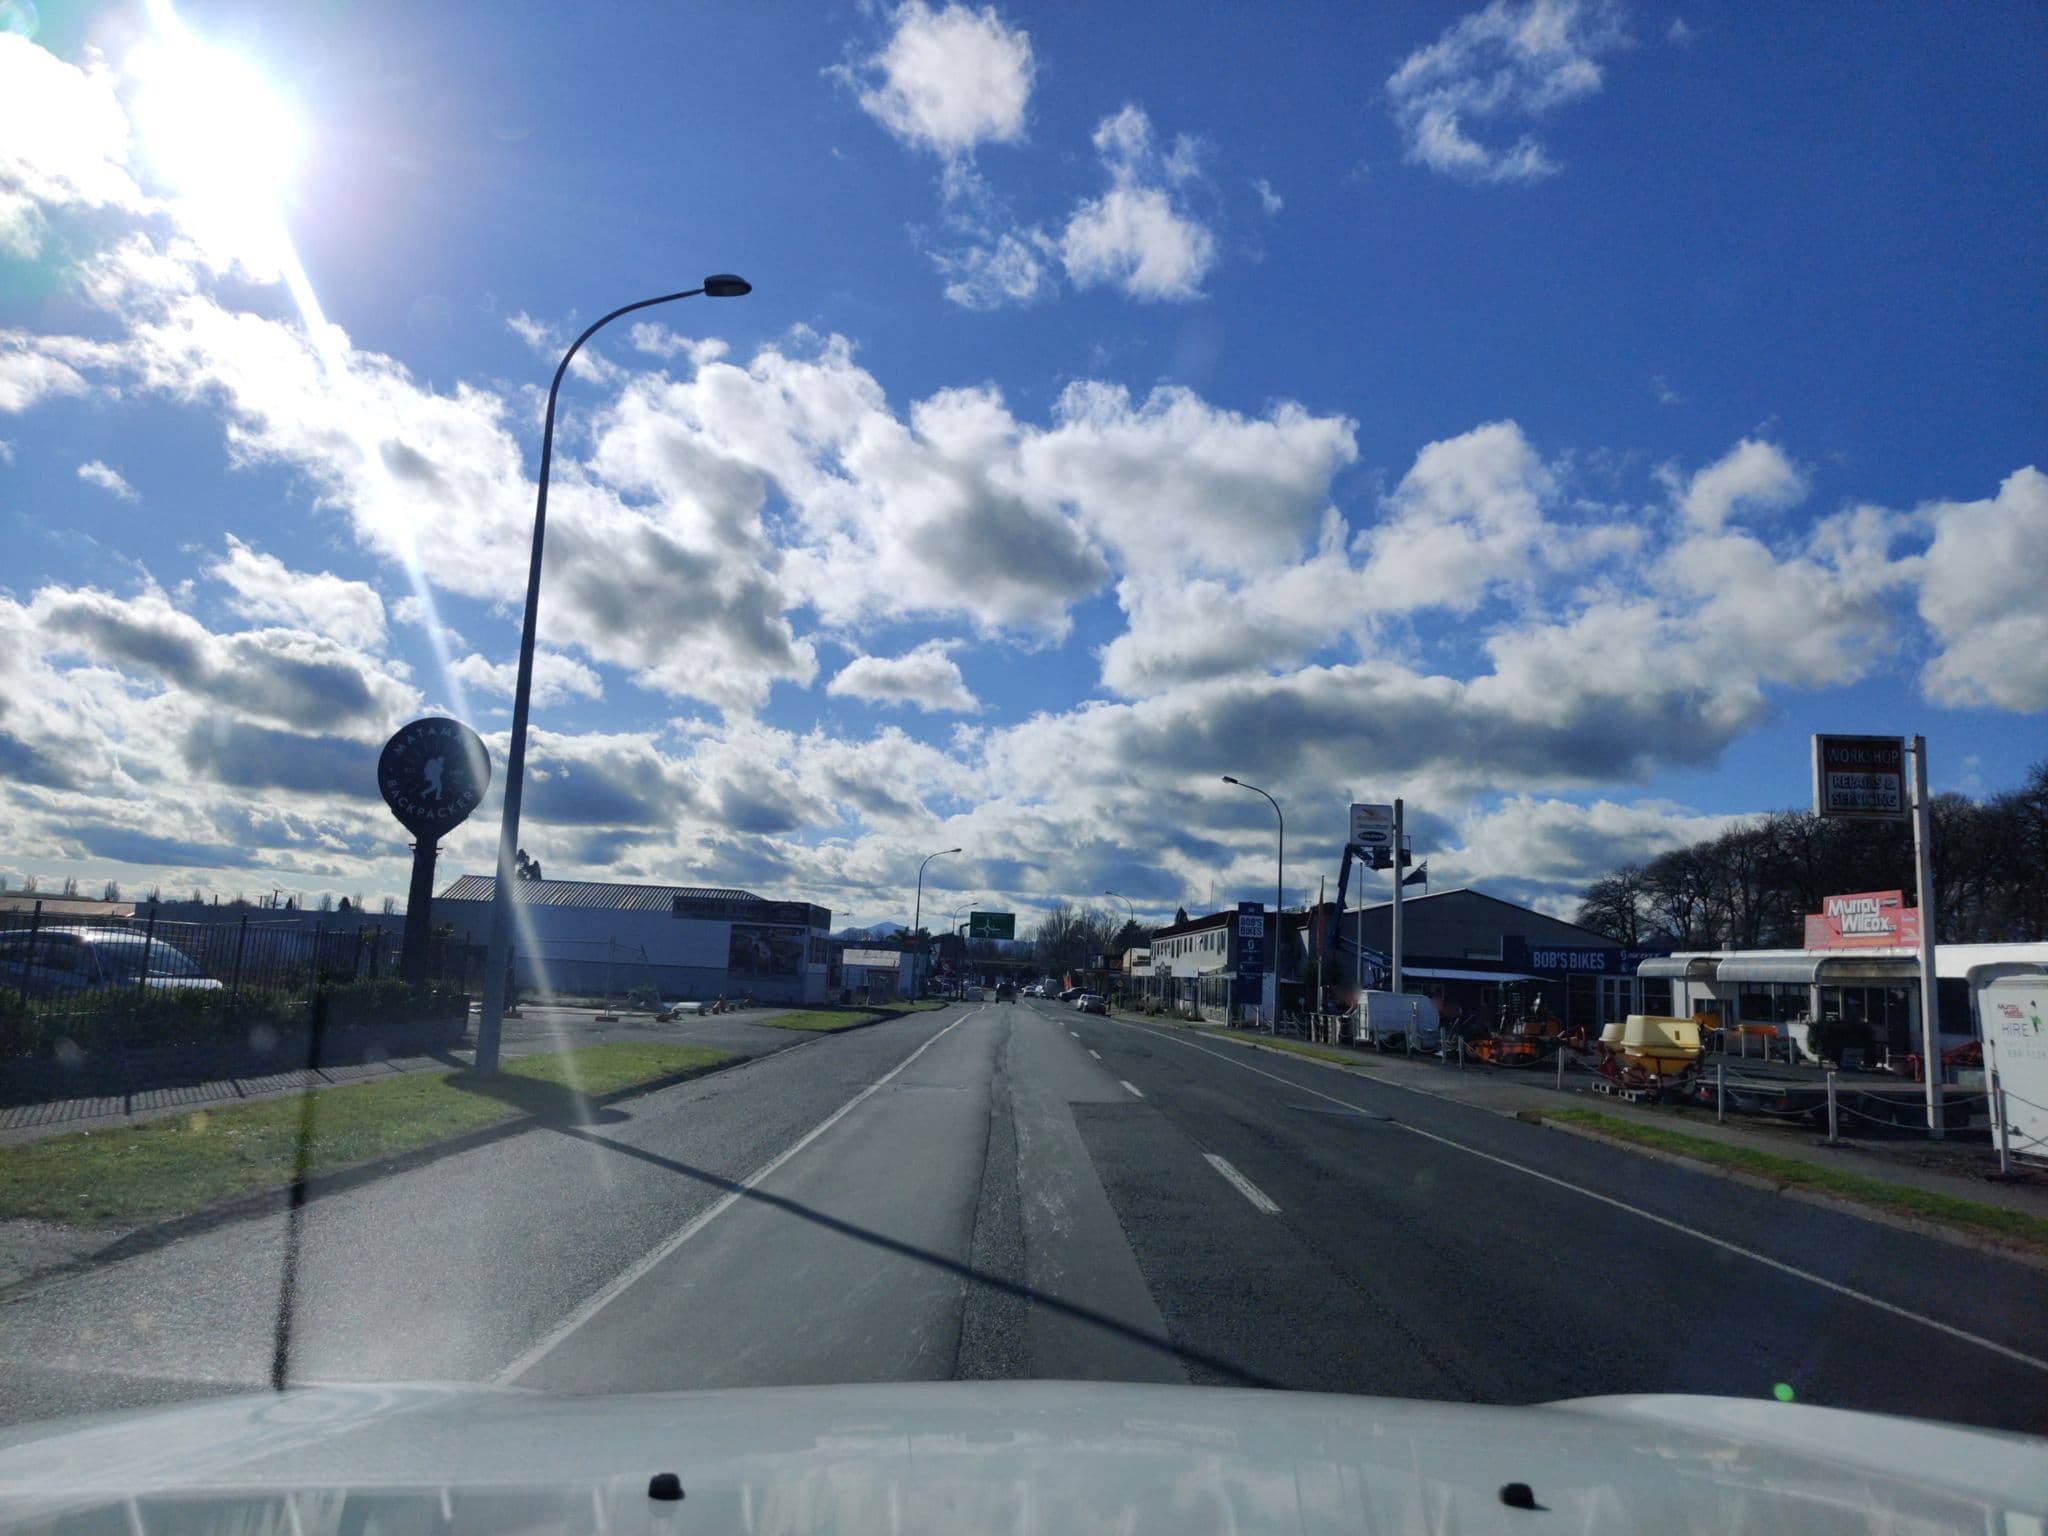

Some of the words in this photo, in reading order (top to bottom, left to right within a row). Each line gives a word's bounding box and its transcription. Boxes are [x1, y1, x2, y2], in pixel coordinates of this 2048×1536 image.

[1832, 775, 1881, 790] REPAIRS
[387, 779, 477, 820] BACKPACKER
[1833, 792, 1897, 806] SERVICING
[1828, 898, 1880, 917] Murray
[1842, 914, 1890, 932] Wilcox
[1533, 952, 1567, 968] BOB'S
[1570, 953, 1605, 970] BIKES
